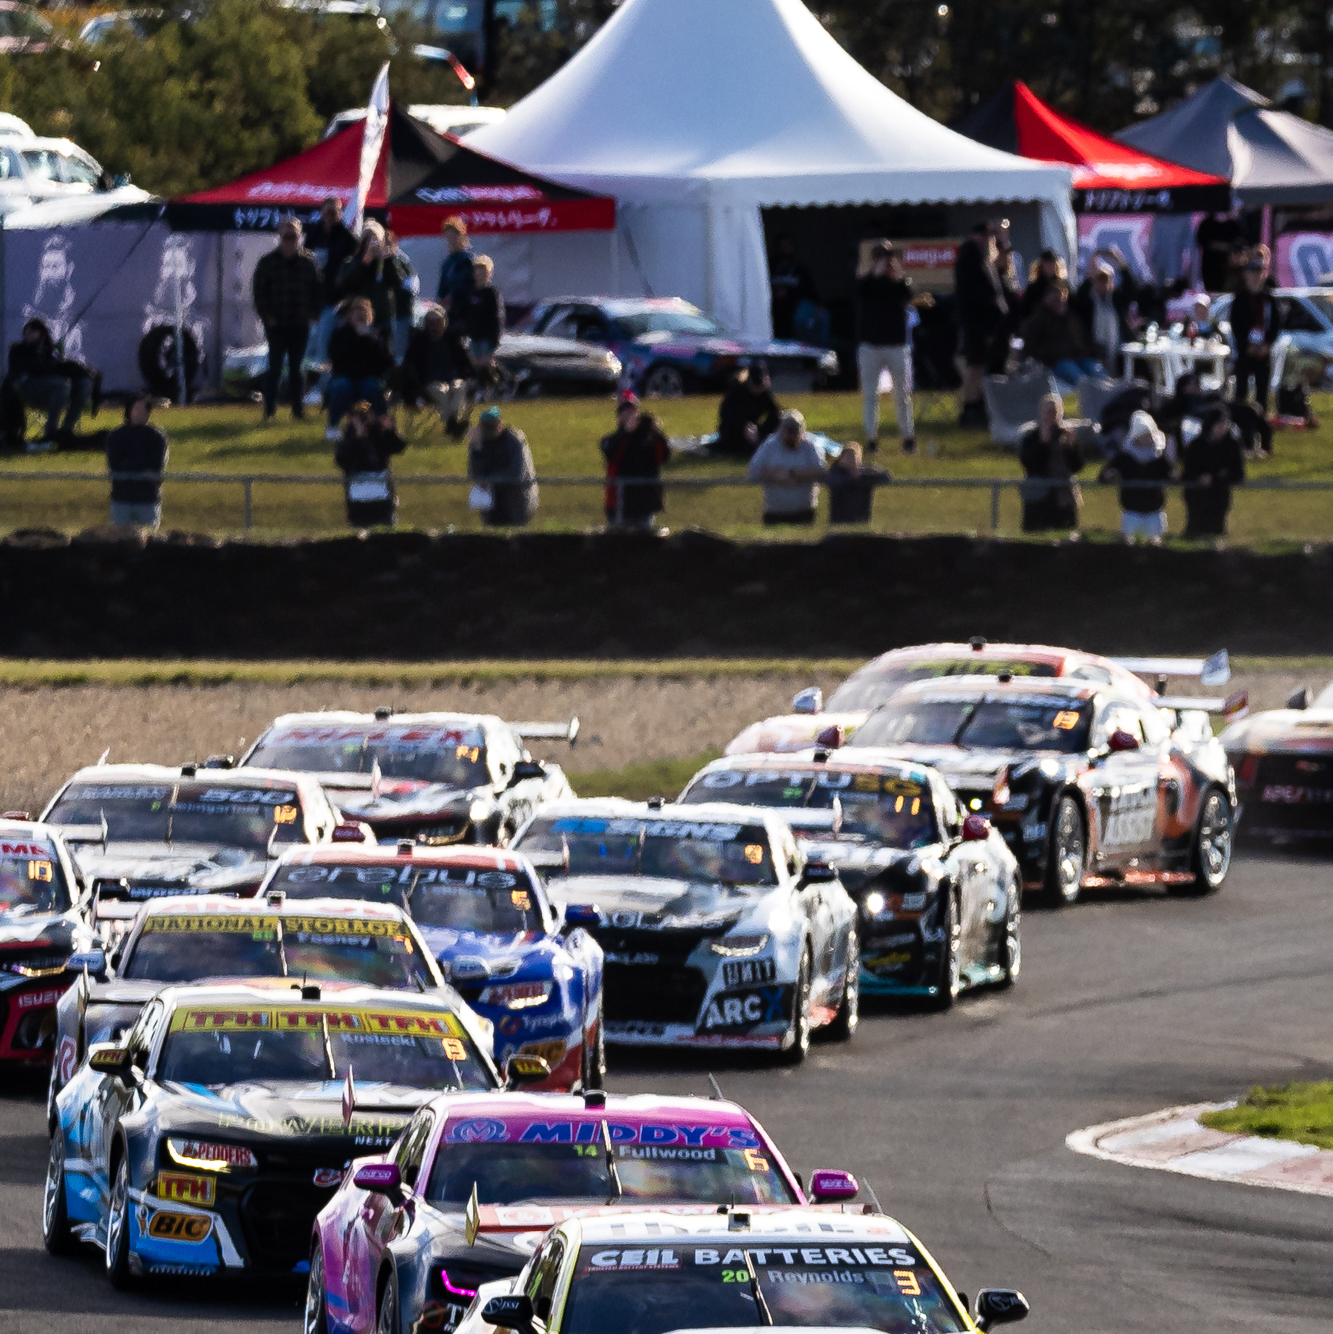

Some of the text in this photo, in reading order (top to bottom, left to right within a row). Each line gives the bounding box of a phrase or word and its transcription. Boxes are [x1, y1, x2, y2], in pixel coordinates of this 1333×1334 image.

[150, 916, 275, 933] NATIONAL
[191, 1011, 267, 1028] TFH
[370, 1014, 448, 1034] TFH
[573, 1144, 598, 1158] 14
[618, 1145, 716, 1161] Fullwood
[162, 1176, 211, 1200] TFH
[154, 1212, 210, 1237] BIC
[694, 1247, 916, 1267] BATTERIES
[721, 1268, 750, 1284] 20
[767, 1268, 864, 1285] Reynolds
